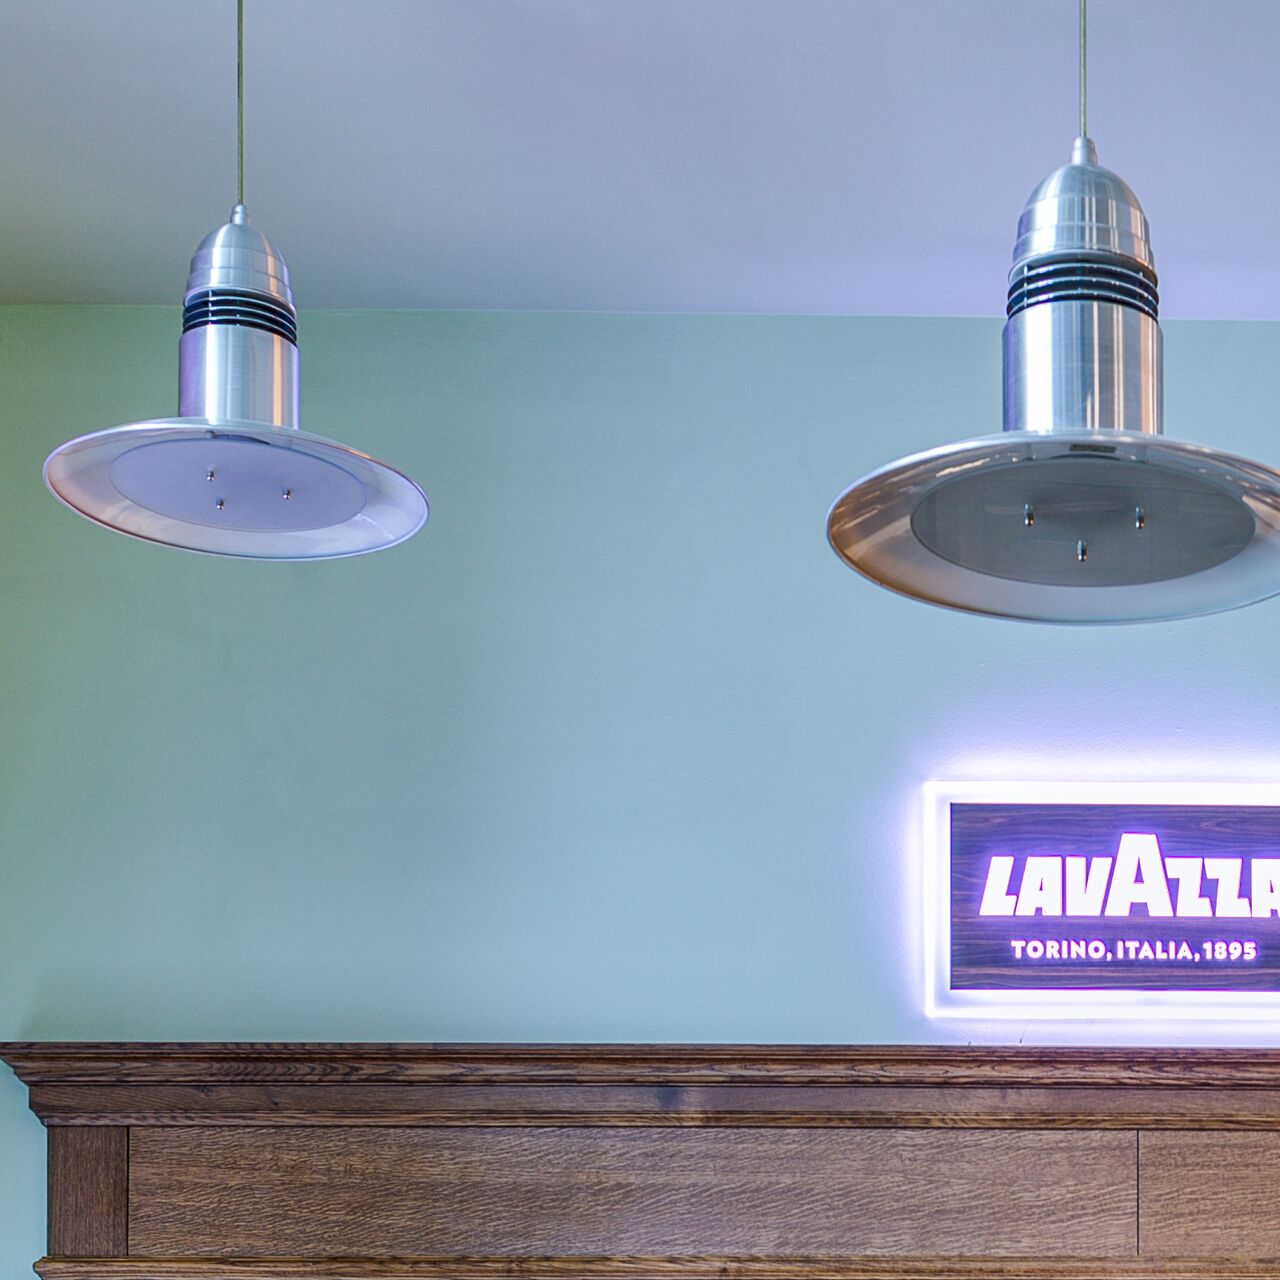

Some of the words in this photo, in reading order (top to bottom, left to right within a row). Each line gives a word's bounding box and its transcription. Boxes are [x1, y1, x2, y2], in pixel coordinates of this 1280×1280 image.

[1011, 940, 1112, 961] TORINO,
[1117, 941, 1200, 962] ITALIA,
[1203, 941, 1257, 961] 1895
